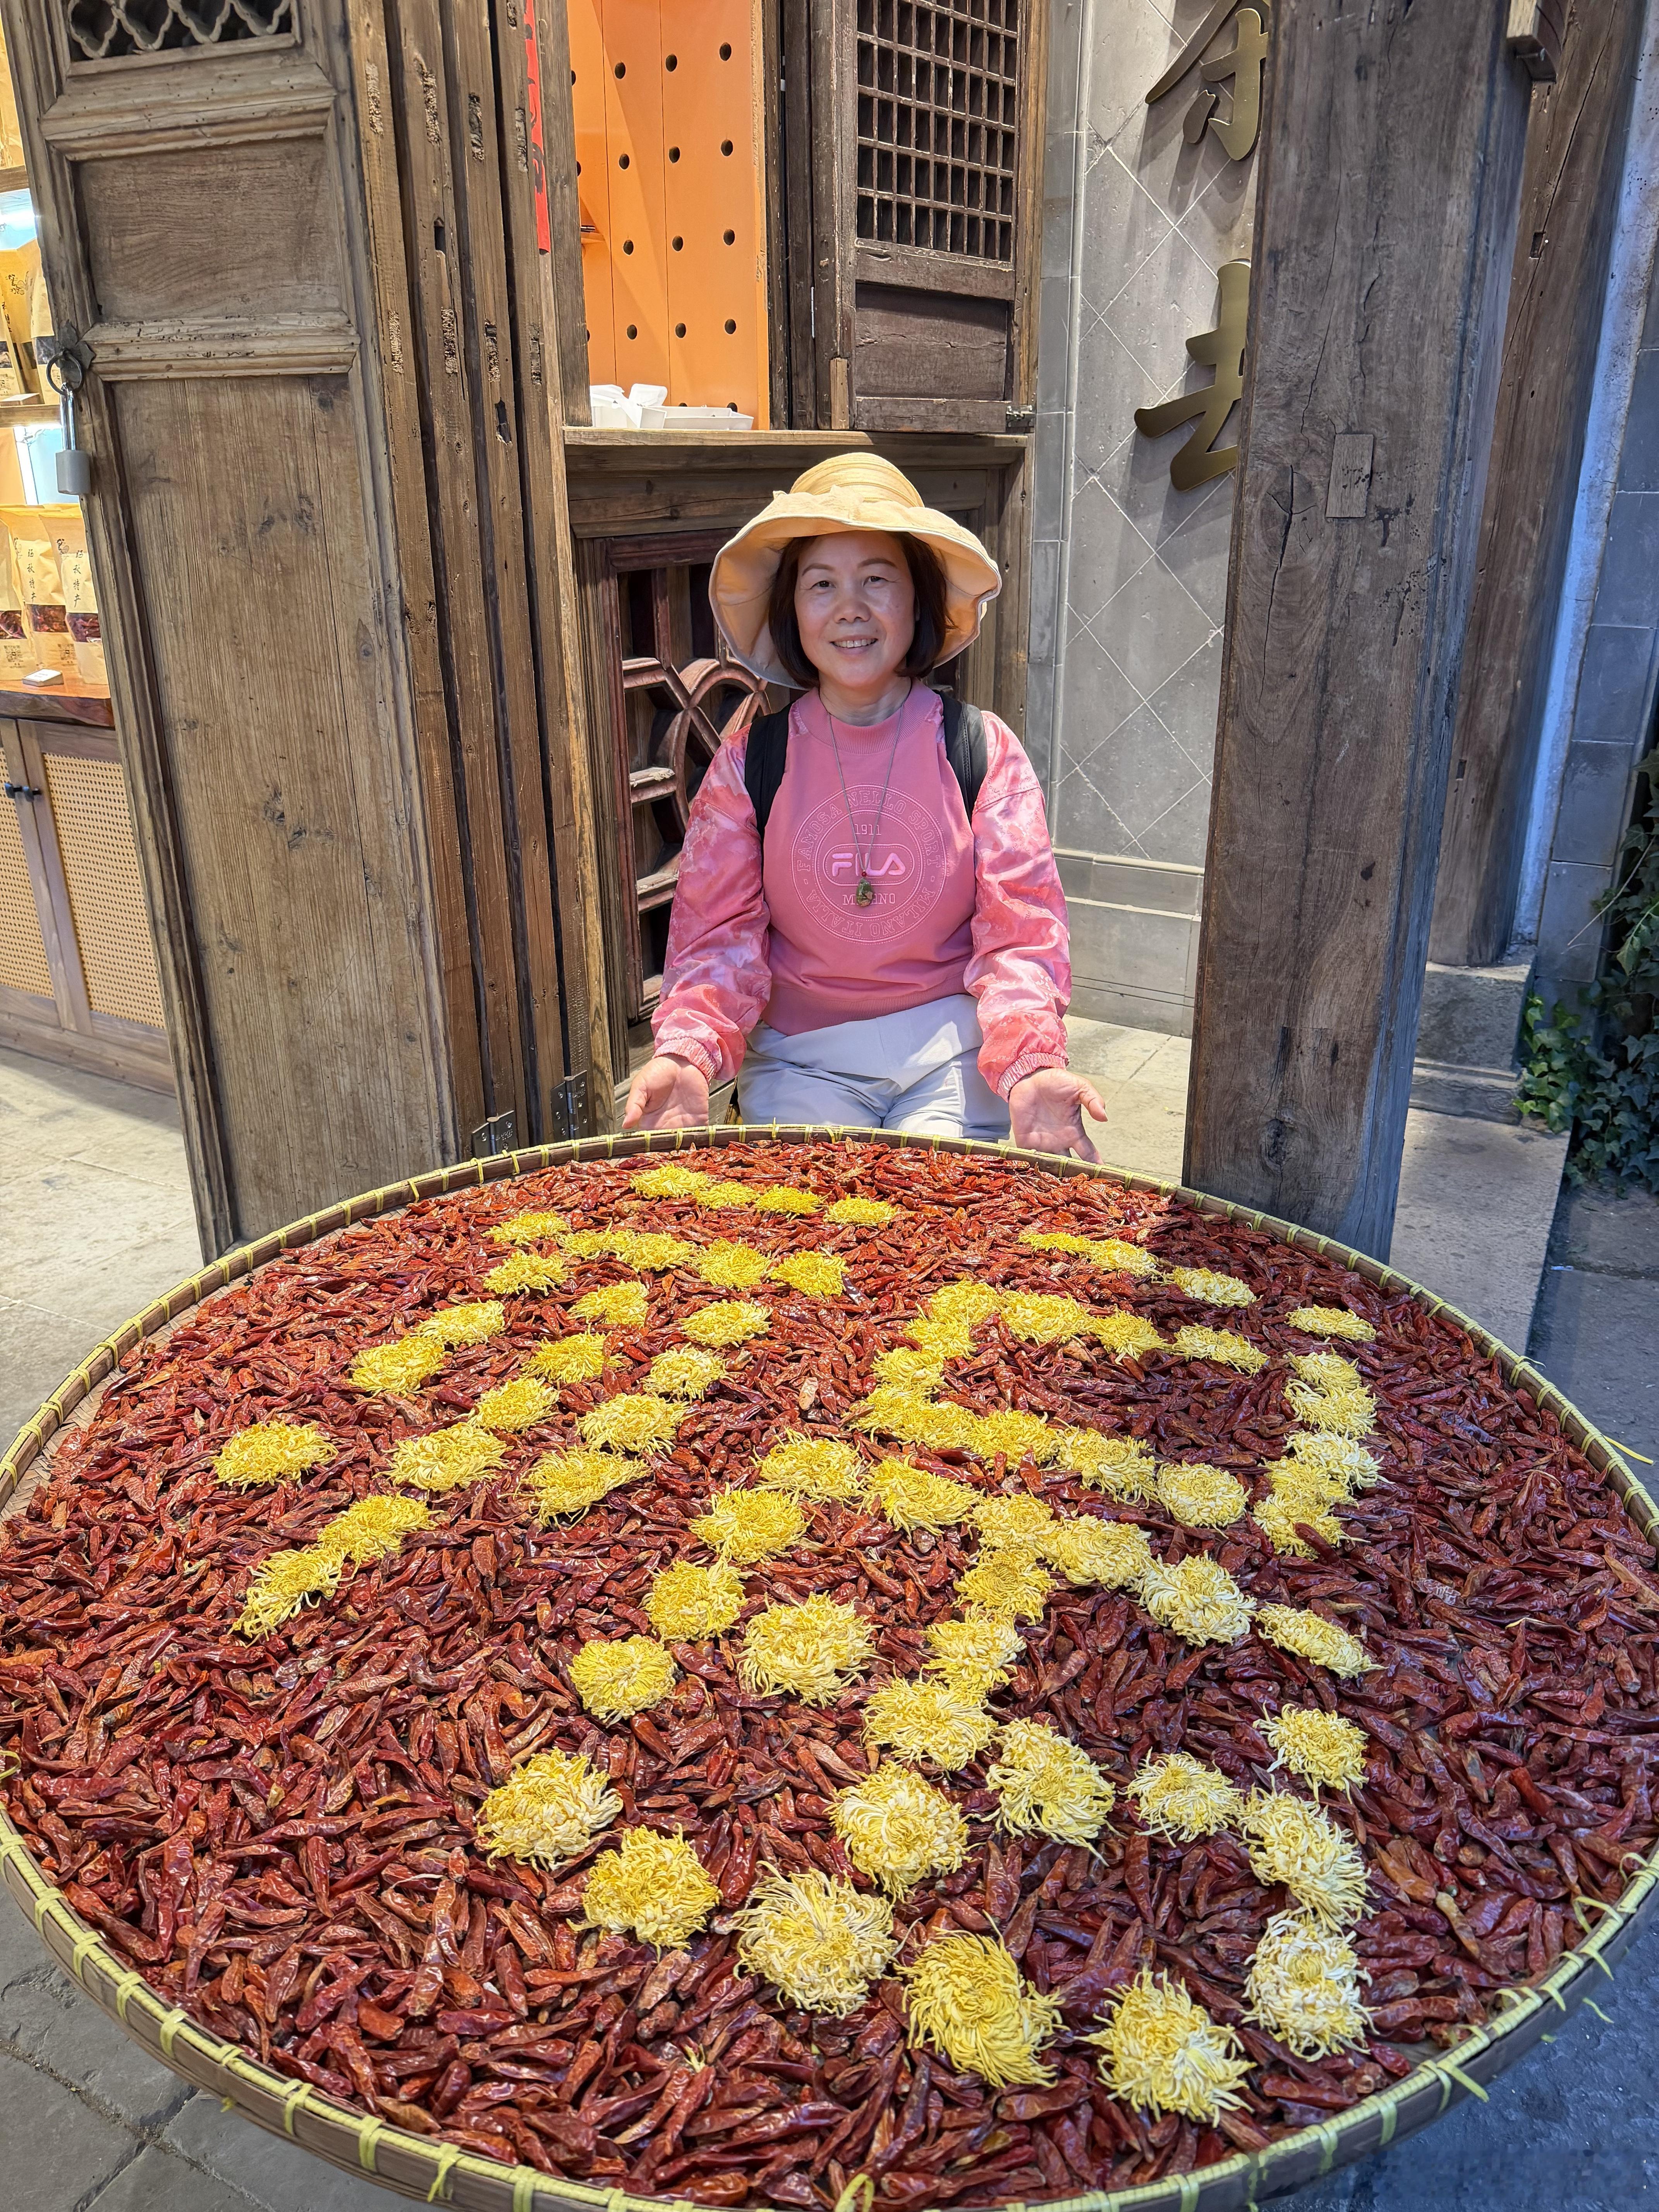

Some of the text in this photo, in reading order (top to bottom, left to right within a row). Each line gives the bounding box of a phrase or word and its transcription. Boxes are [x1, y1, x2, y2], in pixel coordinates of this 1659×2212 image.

[797, 790, 941, 872] FAMOSA NELLO SPORT
[854, 824, 881, 836] 1911
[832, 853, 906, 877] FILA
[842, 893, 895, 905] MANO
[806, 887, 935, 937] MILANO ITALIA
